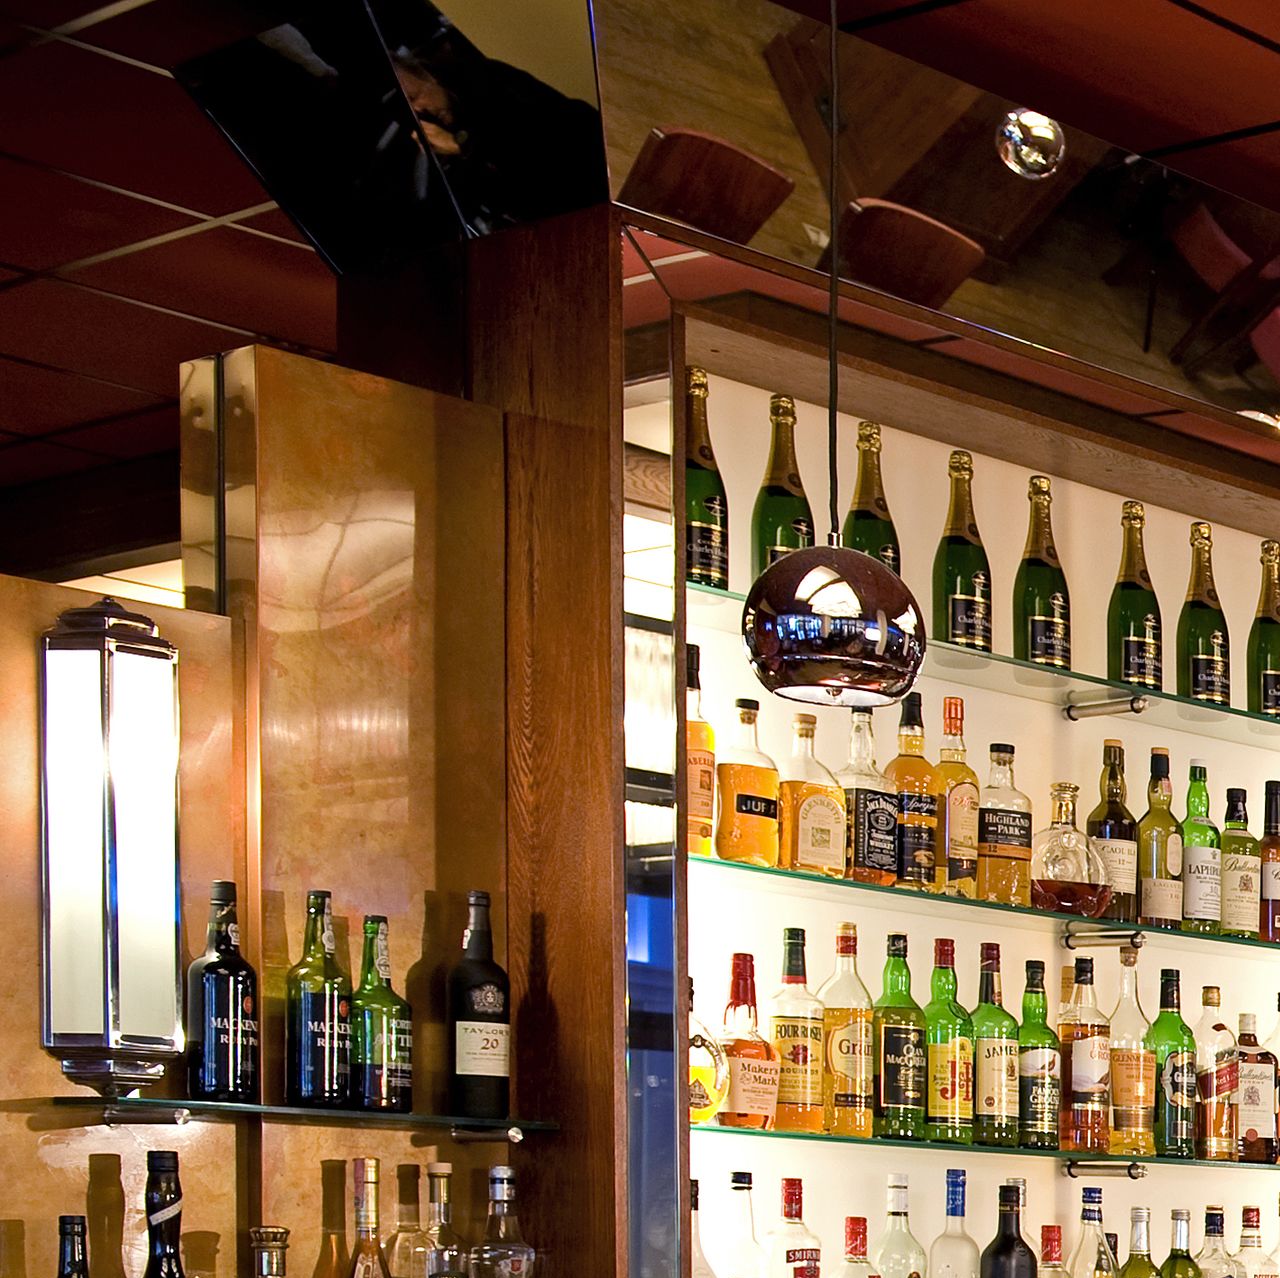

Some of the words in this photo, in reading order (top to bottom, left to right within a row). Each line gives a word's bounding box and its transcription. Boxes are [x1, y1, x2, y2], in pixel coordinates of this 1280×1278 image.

[985, 813, 1029, 827] HIGHLAND
[998, 825, 1020, 835] PARK
[988, 845, 997, 853] 12
[776, 1024, 799, 1039] FOUR
[480, 1038, 499, 1050] 20
[741, 1063, 778, 1075] Maker's
[752, 1074, 778, 1086] Mark
